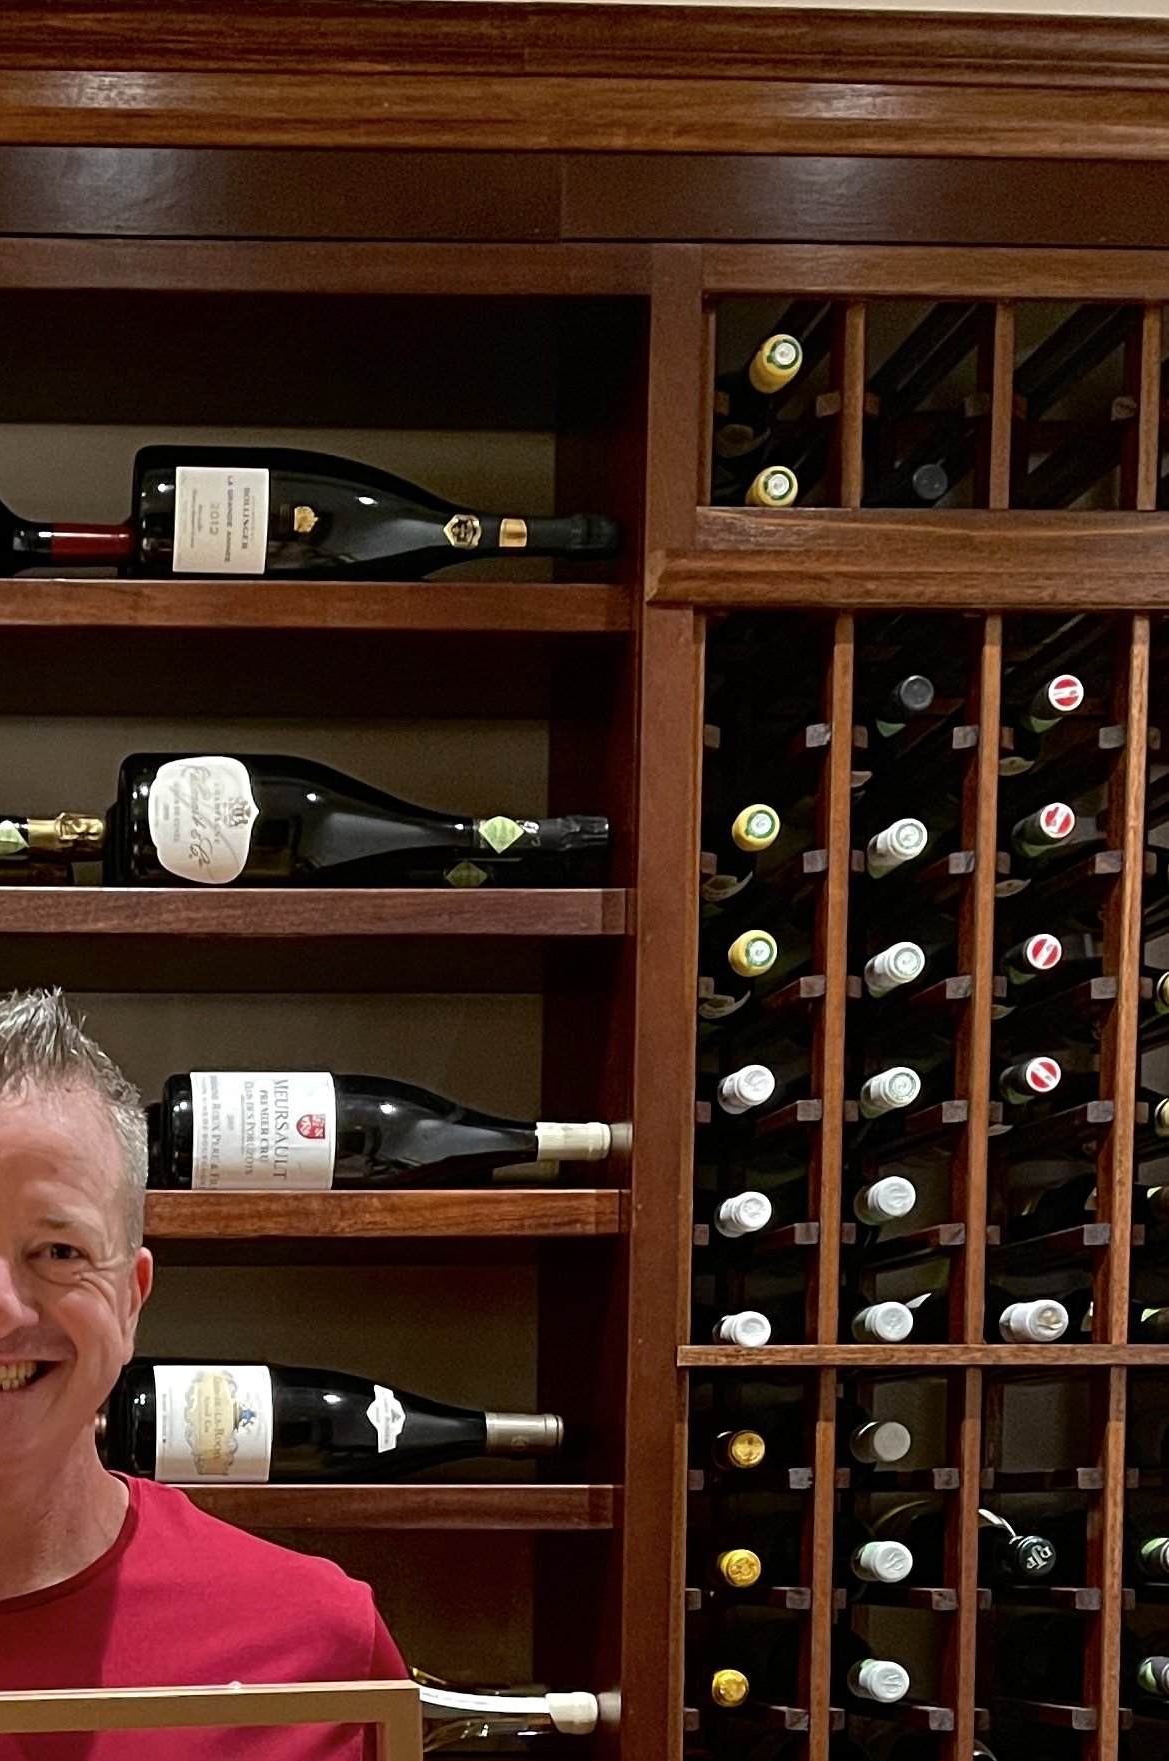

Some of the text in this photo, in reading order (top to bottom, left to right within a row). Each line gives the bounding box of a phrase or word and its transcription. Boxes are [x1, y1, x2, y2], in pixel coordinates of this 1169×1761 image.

[209, 501, 219, 536] 2012
[242, 487, 250, 549] BOLLINGER
[259, 1089, 268, 1163] PREMIER CRU
[272, 1078, 288, 1180] MEURSAULT
